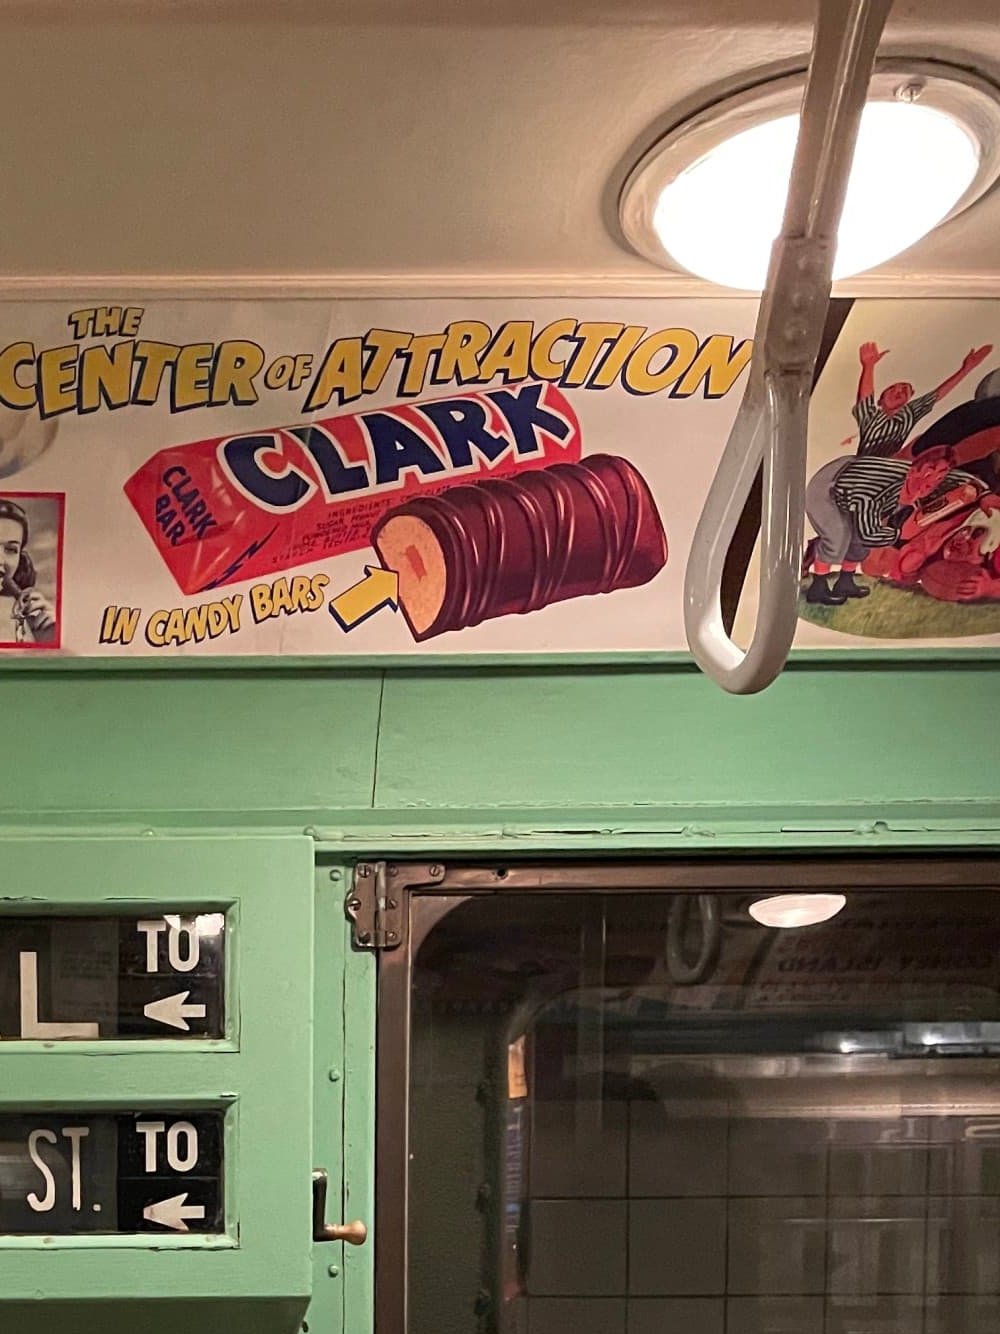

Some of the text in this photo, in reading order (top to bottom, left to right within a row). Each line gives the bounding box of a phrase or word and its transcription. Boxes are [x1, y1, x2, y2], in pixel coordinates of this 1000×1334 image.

[67, 306, 145, 340] THE
[264, 354, 313, 390] OF
[302, 317, 755, 413] ATTRACTION
[216, 378, 577, 514] CLARK
[154, 493, 187, 547] BAR
[162, 465, 217, 541] CLARK
[99, 574, 331, 646] IN CANDY BARS
[136, 920, 200, 972] TO
[27, 1126, 102, 1213] ST.
[135, 1120, 199, 1173] TO
